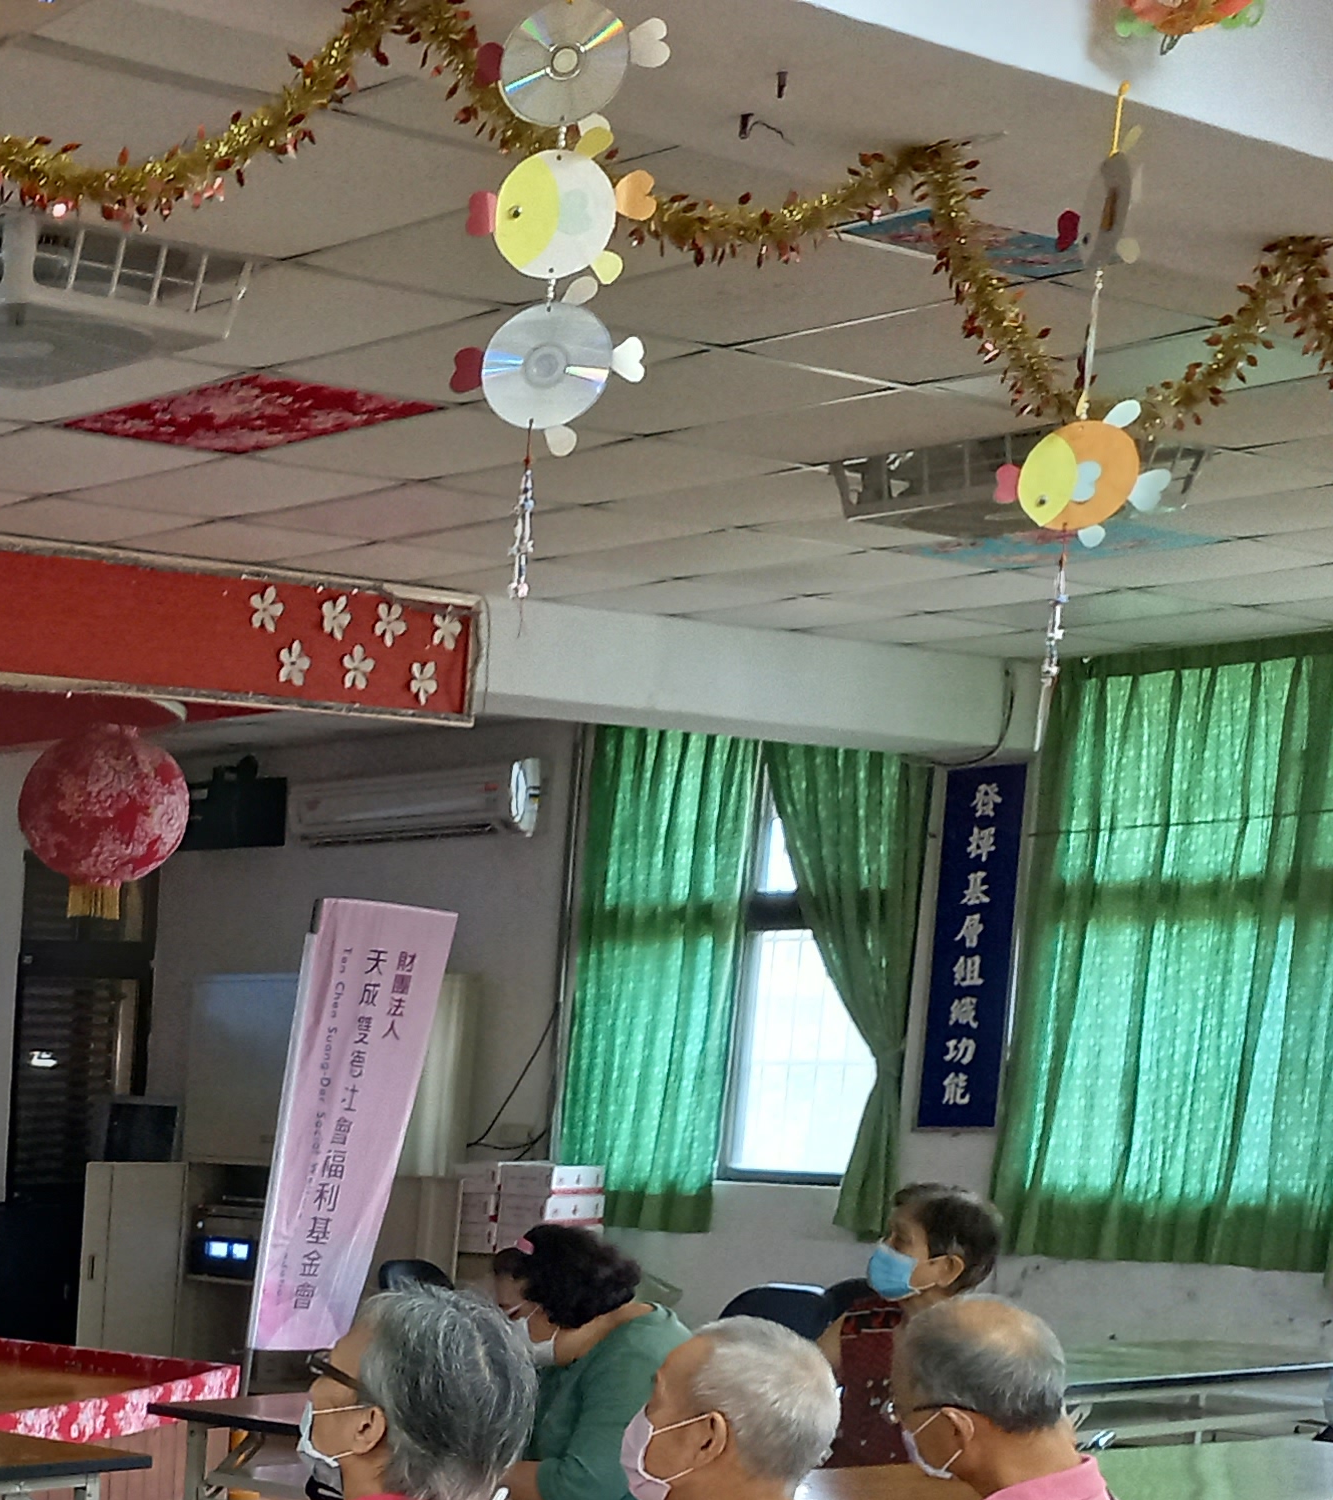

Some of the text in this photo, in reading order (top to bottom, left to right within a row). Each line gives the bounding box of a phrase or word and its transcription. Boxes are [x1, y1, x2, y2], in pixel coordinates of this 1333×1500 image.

[382, 951, 416, 1040] 財團法人
[942, 782, 1002, 1105] 發揮基層組織功能
